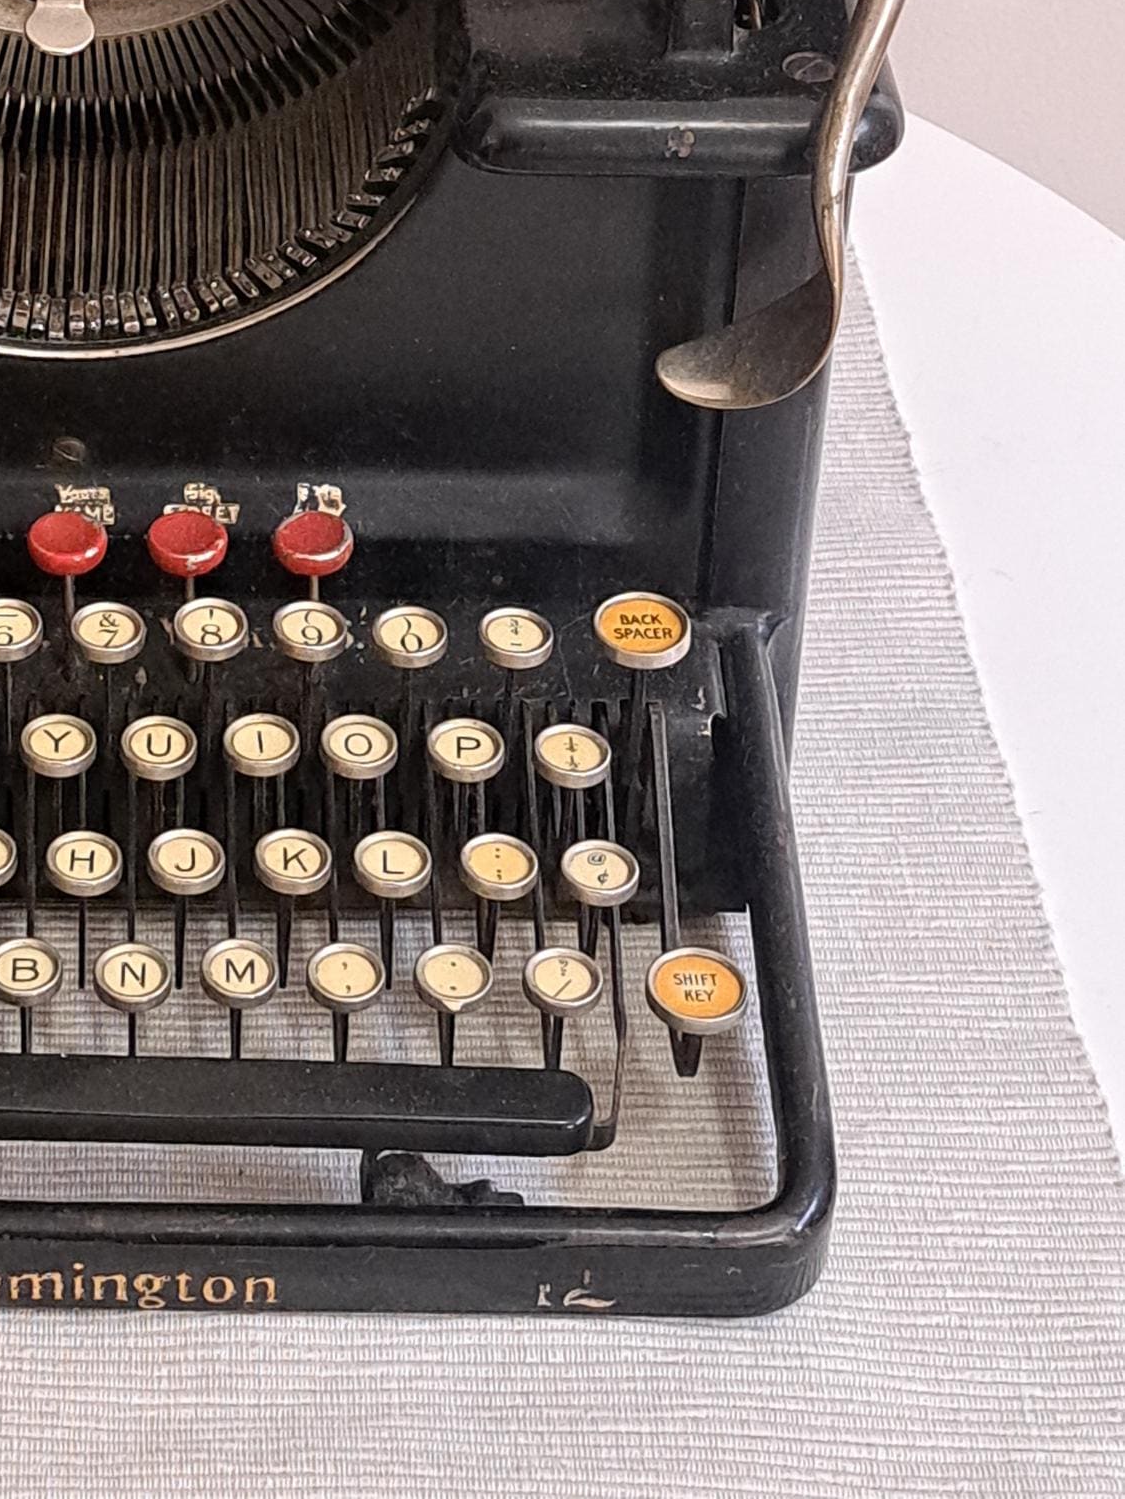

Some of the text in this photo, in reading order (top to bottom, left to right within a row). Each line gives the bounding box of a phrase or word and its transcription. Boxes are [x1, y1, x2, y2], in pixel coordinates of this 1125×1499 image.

[98, 613, 120, 628] &
[619, 613, 663, 626] BACK
[98, 628, 120, 648] 7
[200, 624, 223, 645] 8
[300, 625, 323, 646] 9
[613, 626, 674, 641] SPACER
[42, 730, 72, 753] Y
[146, 733, 172, 757] U
[344, 732, 373, 757] O
[456, 736, 481, 759] P
[69, 849, 95, 873] H
[175, 847, 196, 872] J
[282, 847, 308, 872] K
[383, 850, 405, 874] L
[587, 852, 606, 866] @
[11, 958, 40, 983] B
[120, 962, 146, 988] N
[225, 958, 256, 984] M
[672, 972, 717, 988] SHIFT
[684, 988, 715, 1003] KEY
